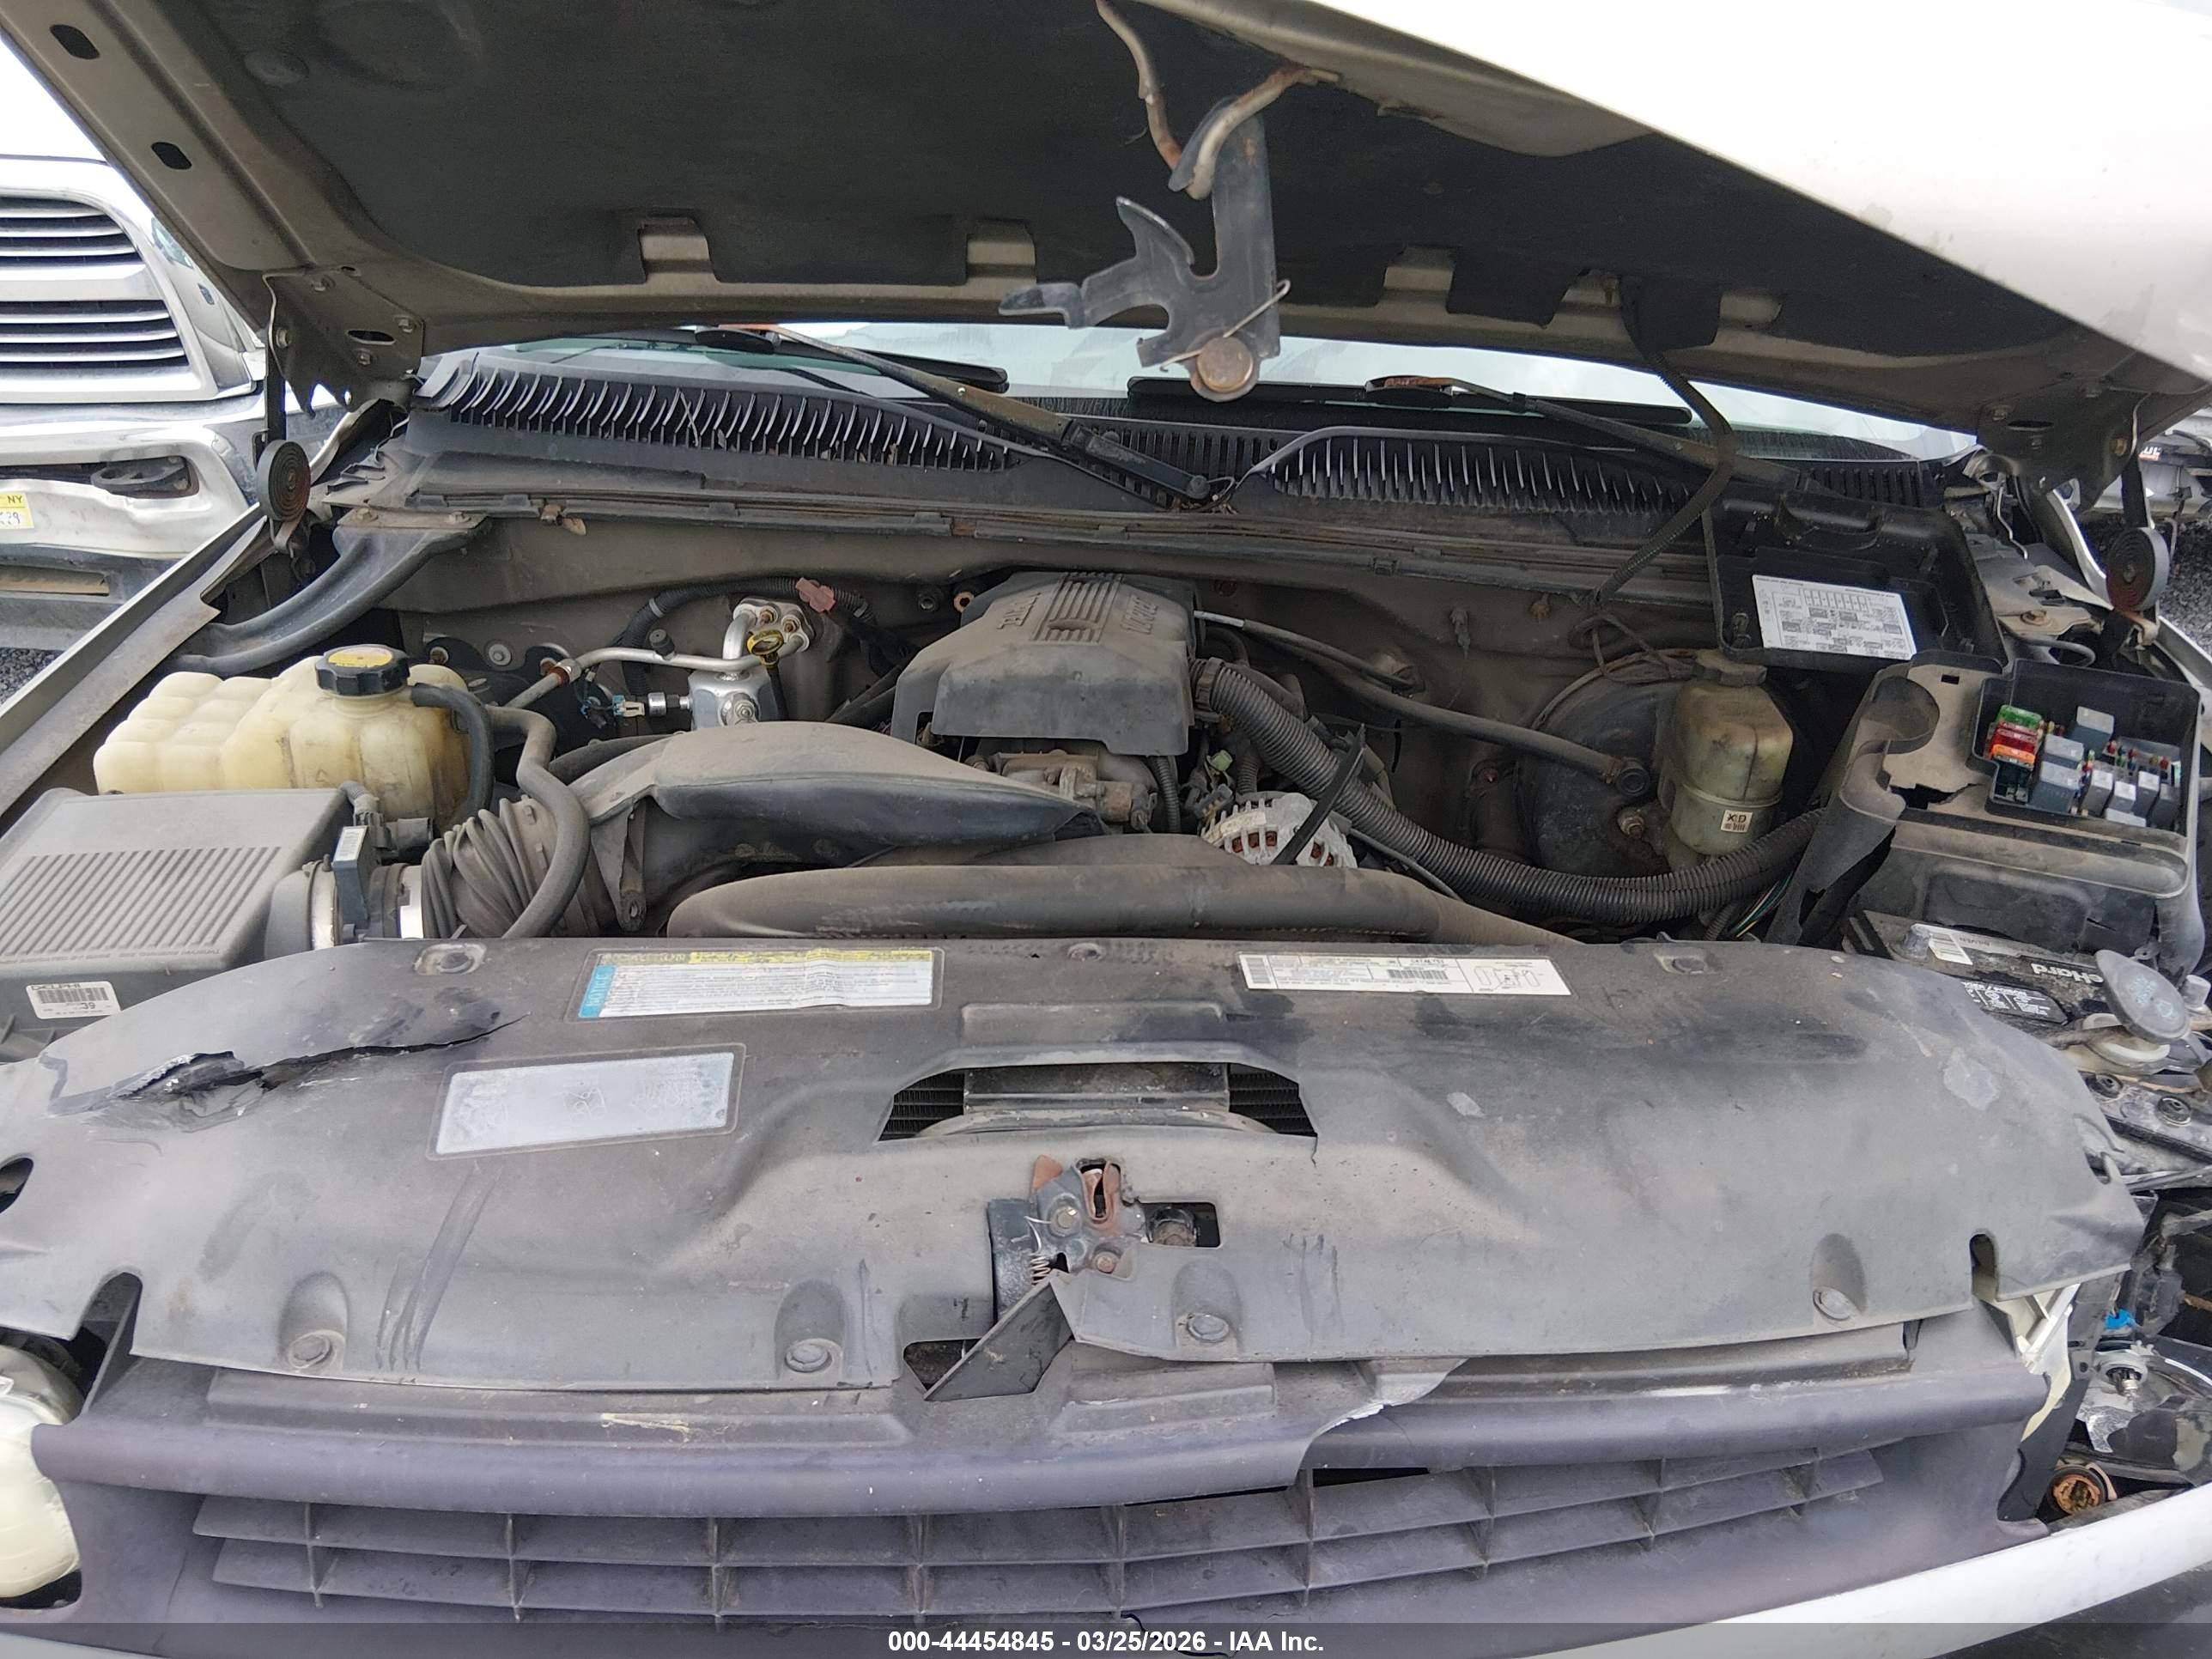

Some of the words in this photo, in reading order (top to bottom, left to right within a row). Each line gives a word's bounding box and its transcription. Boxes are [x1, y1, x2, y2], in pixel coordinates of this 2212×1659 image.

[7, 495, 22, 504] NY
[2031, 963, 2105, 984] eHard
[81, 1001, 96, 1010] 39
